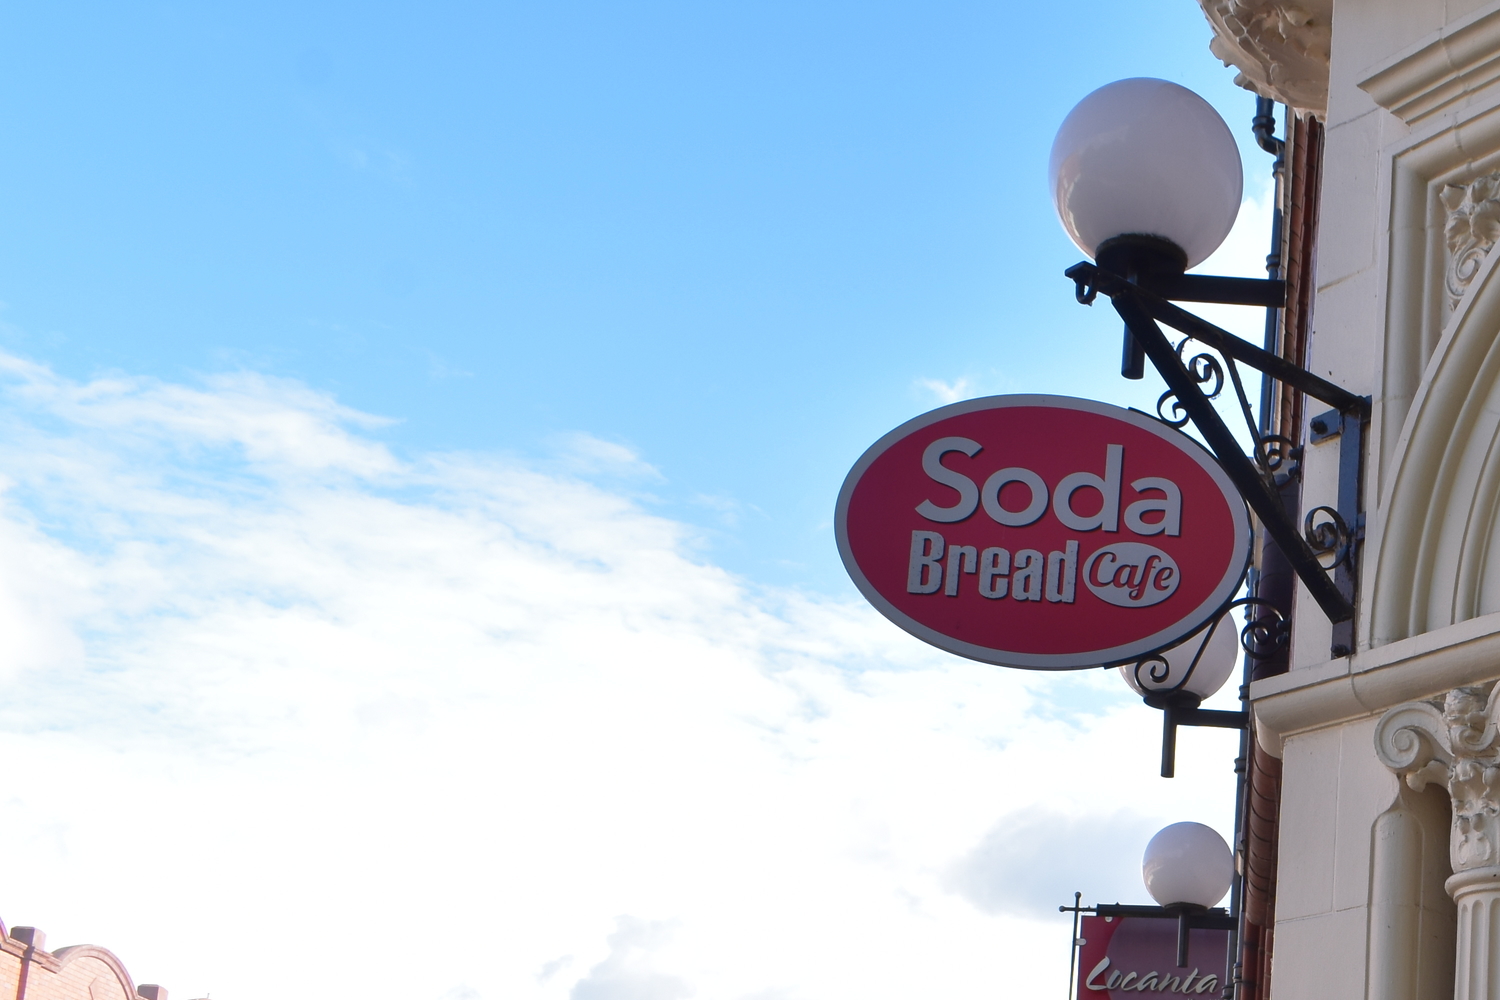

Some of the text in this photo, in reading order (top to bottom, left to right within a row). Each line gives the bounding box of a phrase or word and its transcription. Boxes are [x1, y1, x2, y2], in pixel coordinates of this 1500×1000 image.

[914, 436, 1182, 537] Soda
[906, 530, 1174, 604] Bread Cafe
[1085, 955, 1219, 994] Locanta
